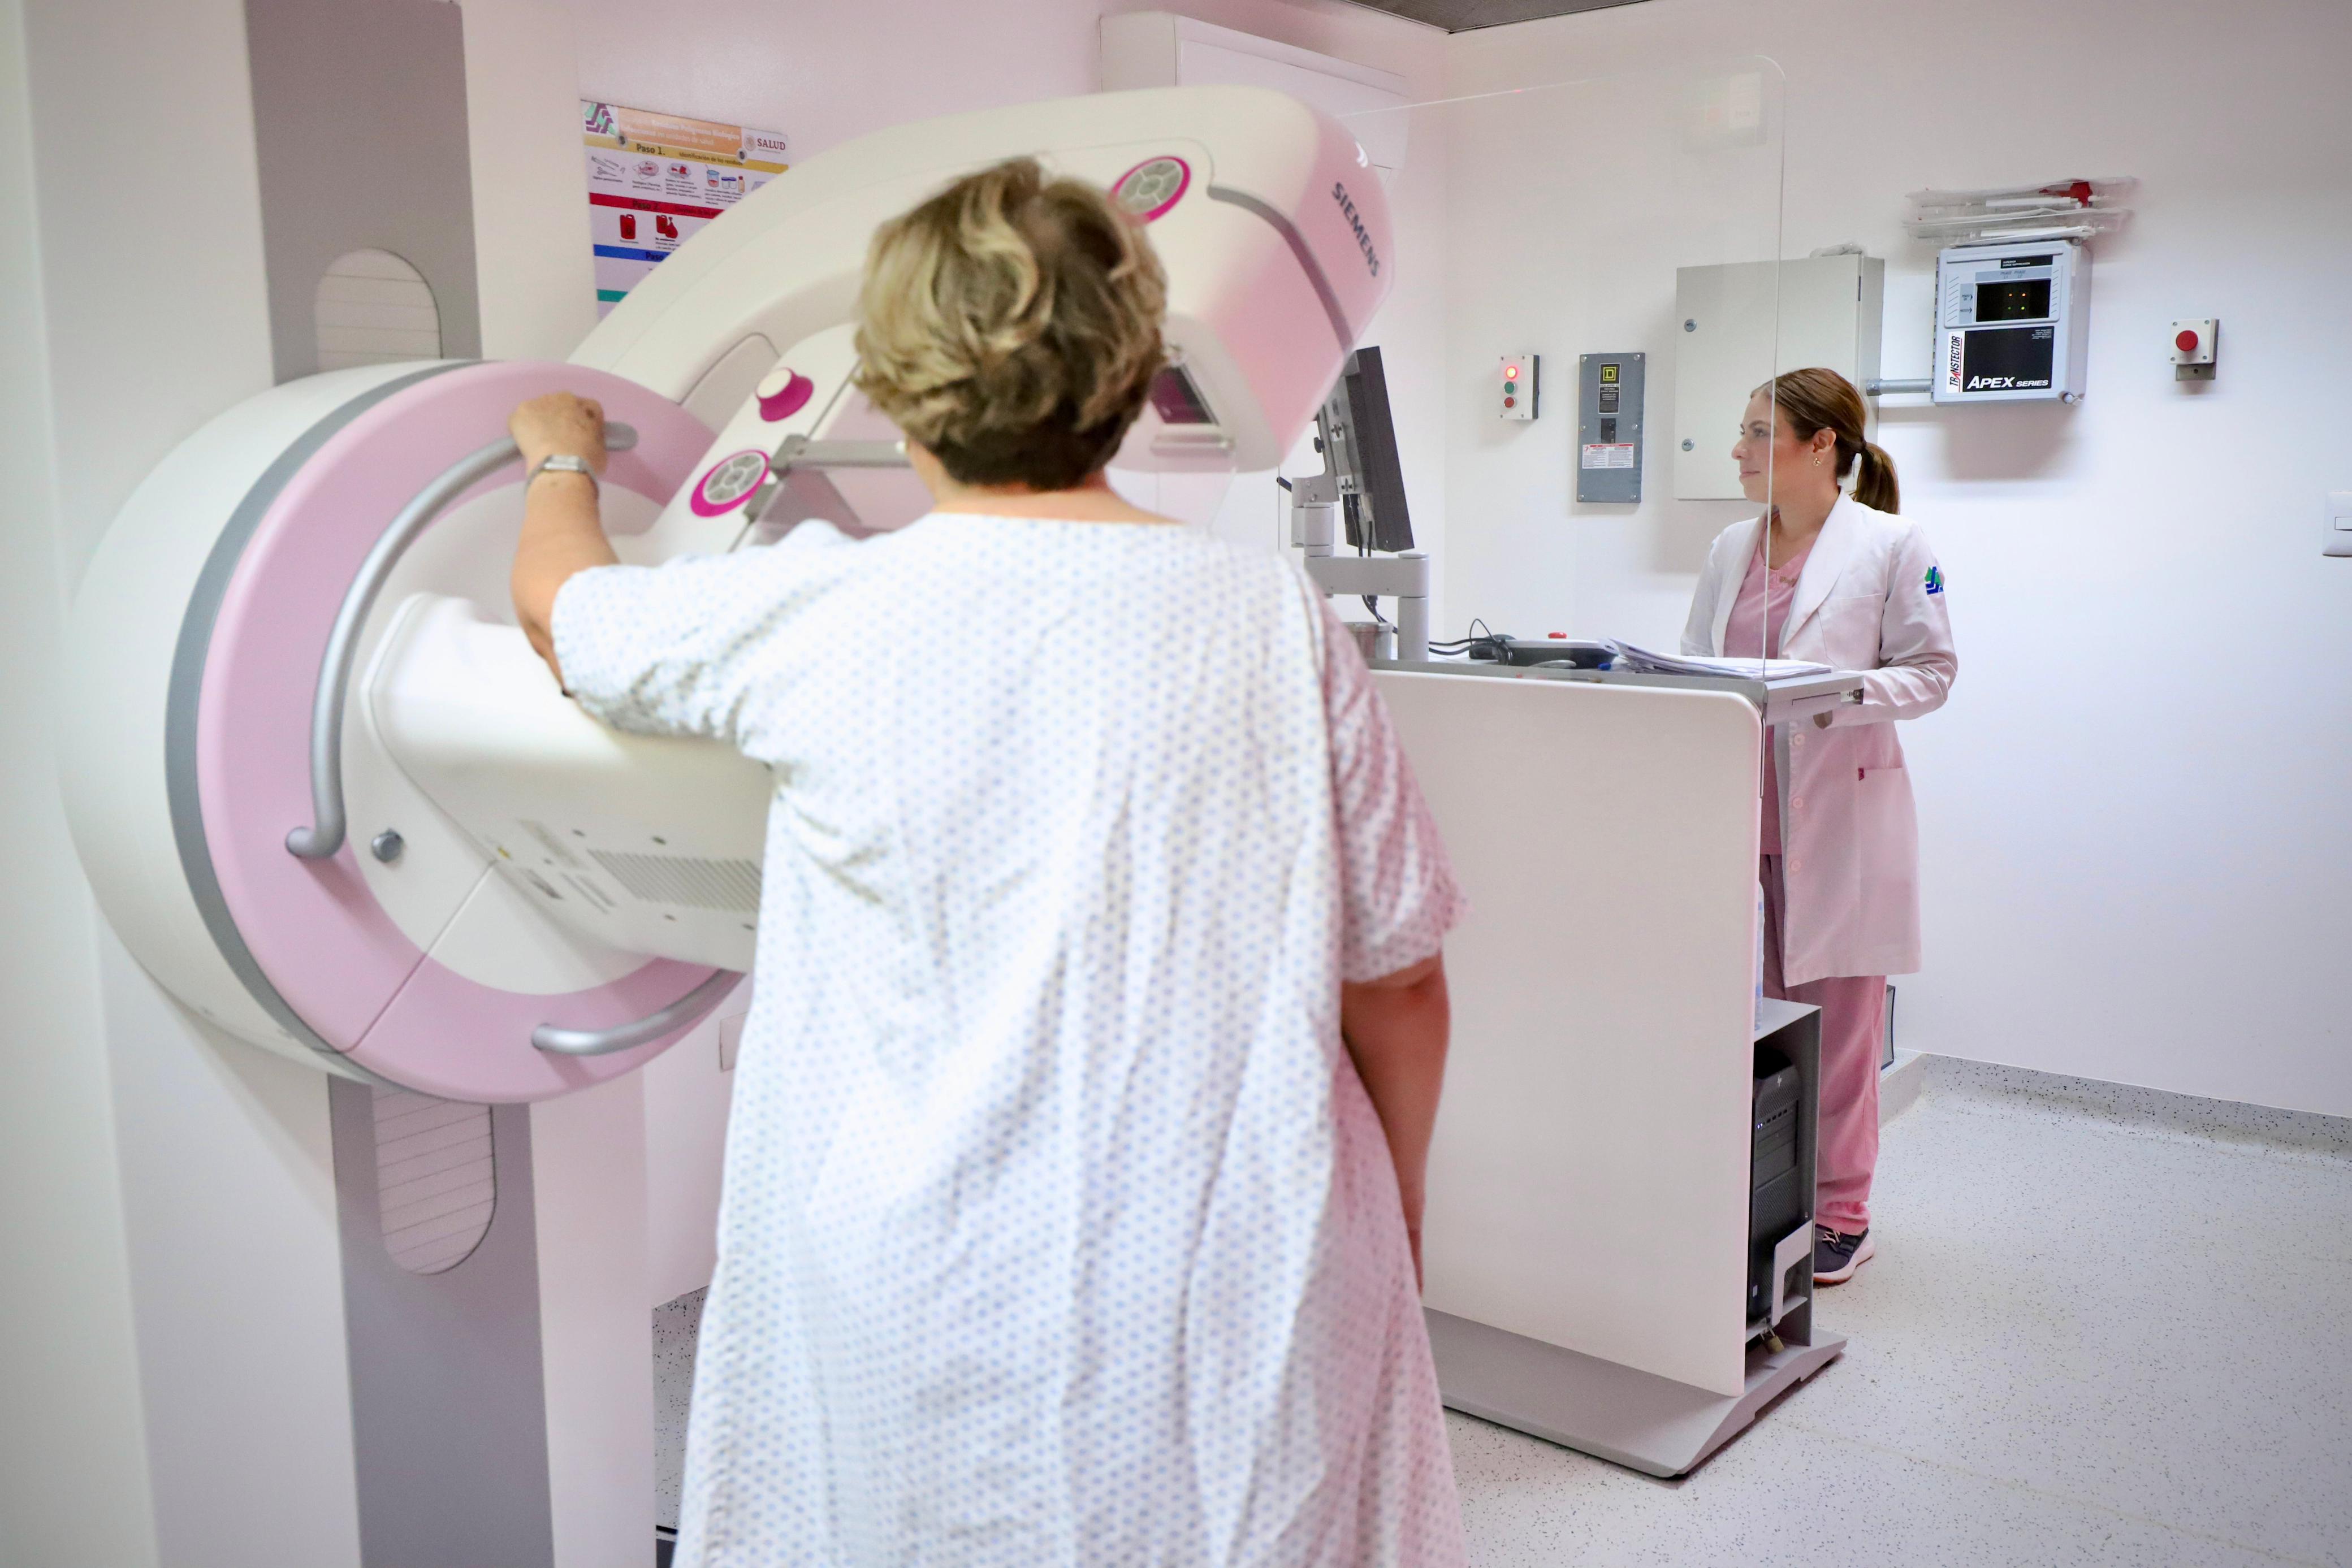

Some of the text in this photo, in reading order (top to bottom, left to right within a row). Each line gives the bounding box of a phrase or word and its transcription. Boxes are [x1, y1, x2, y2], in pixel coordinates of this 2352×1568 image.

[636, 144, 655, 154] Paso
[757, 138, 785, 150] SALUD
[633, 200, 651, 209] Paso
[1332, 181, 1380, 278] SIEMENS
[646, 251, 664, 261] Paso
[1966, 375, 2015, 389] APEX
